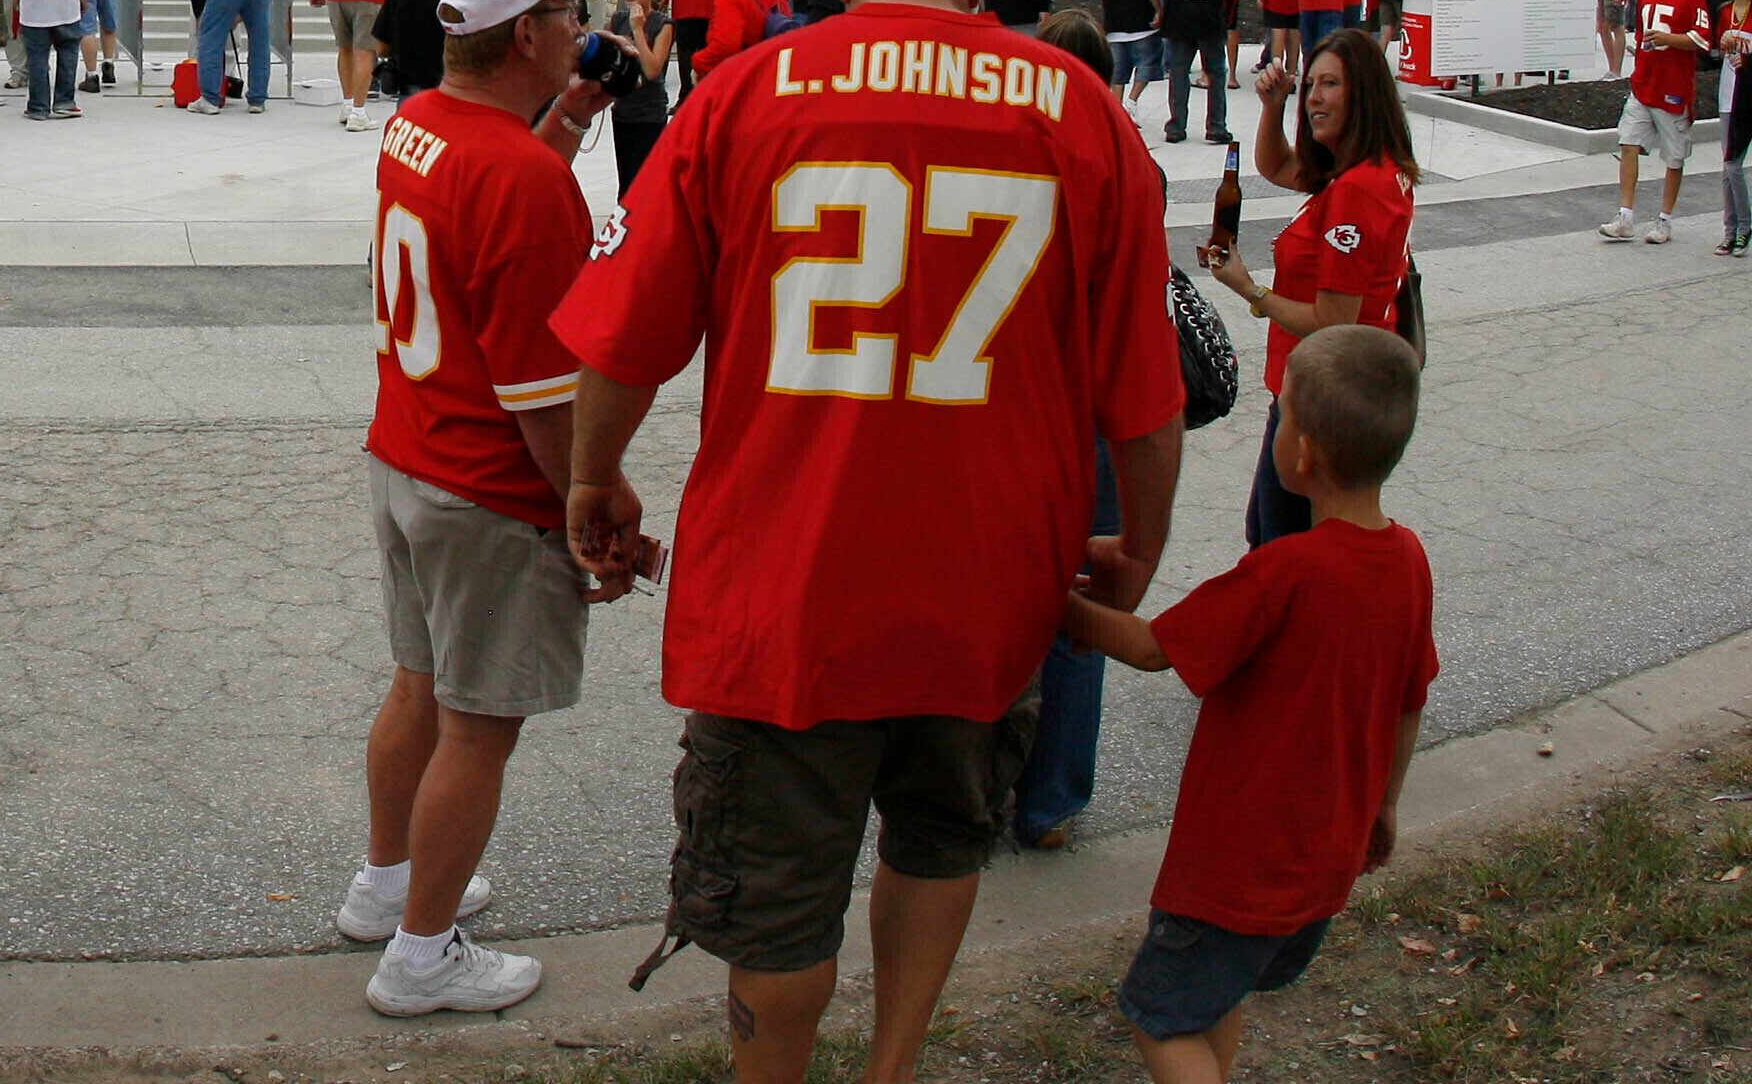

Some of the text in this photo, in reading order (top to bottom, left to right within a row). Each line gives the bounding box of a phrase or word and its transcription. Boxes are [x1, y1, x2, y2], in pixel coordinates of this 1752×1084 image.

[1640, 3, 1674, 51] 15
[1695, 7, 1710, 29] 15
[382, 116, 448, 178] GREEN
[1335, 227, 1357, 248] KC
[764, 160, 1060, 406] 27
